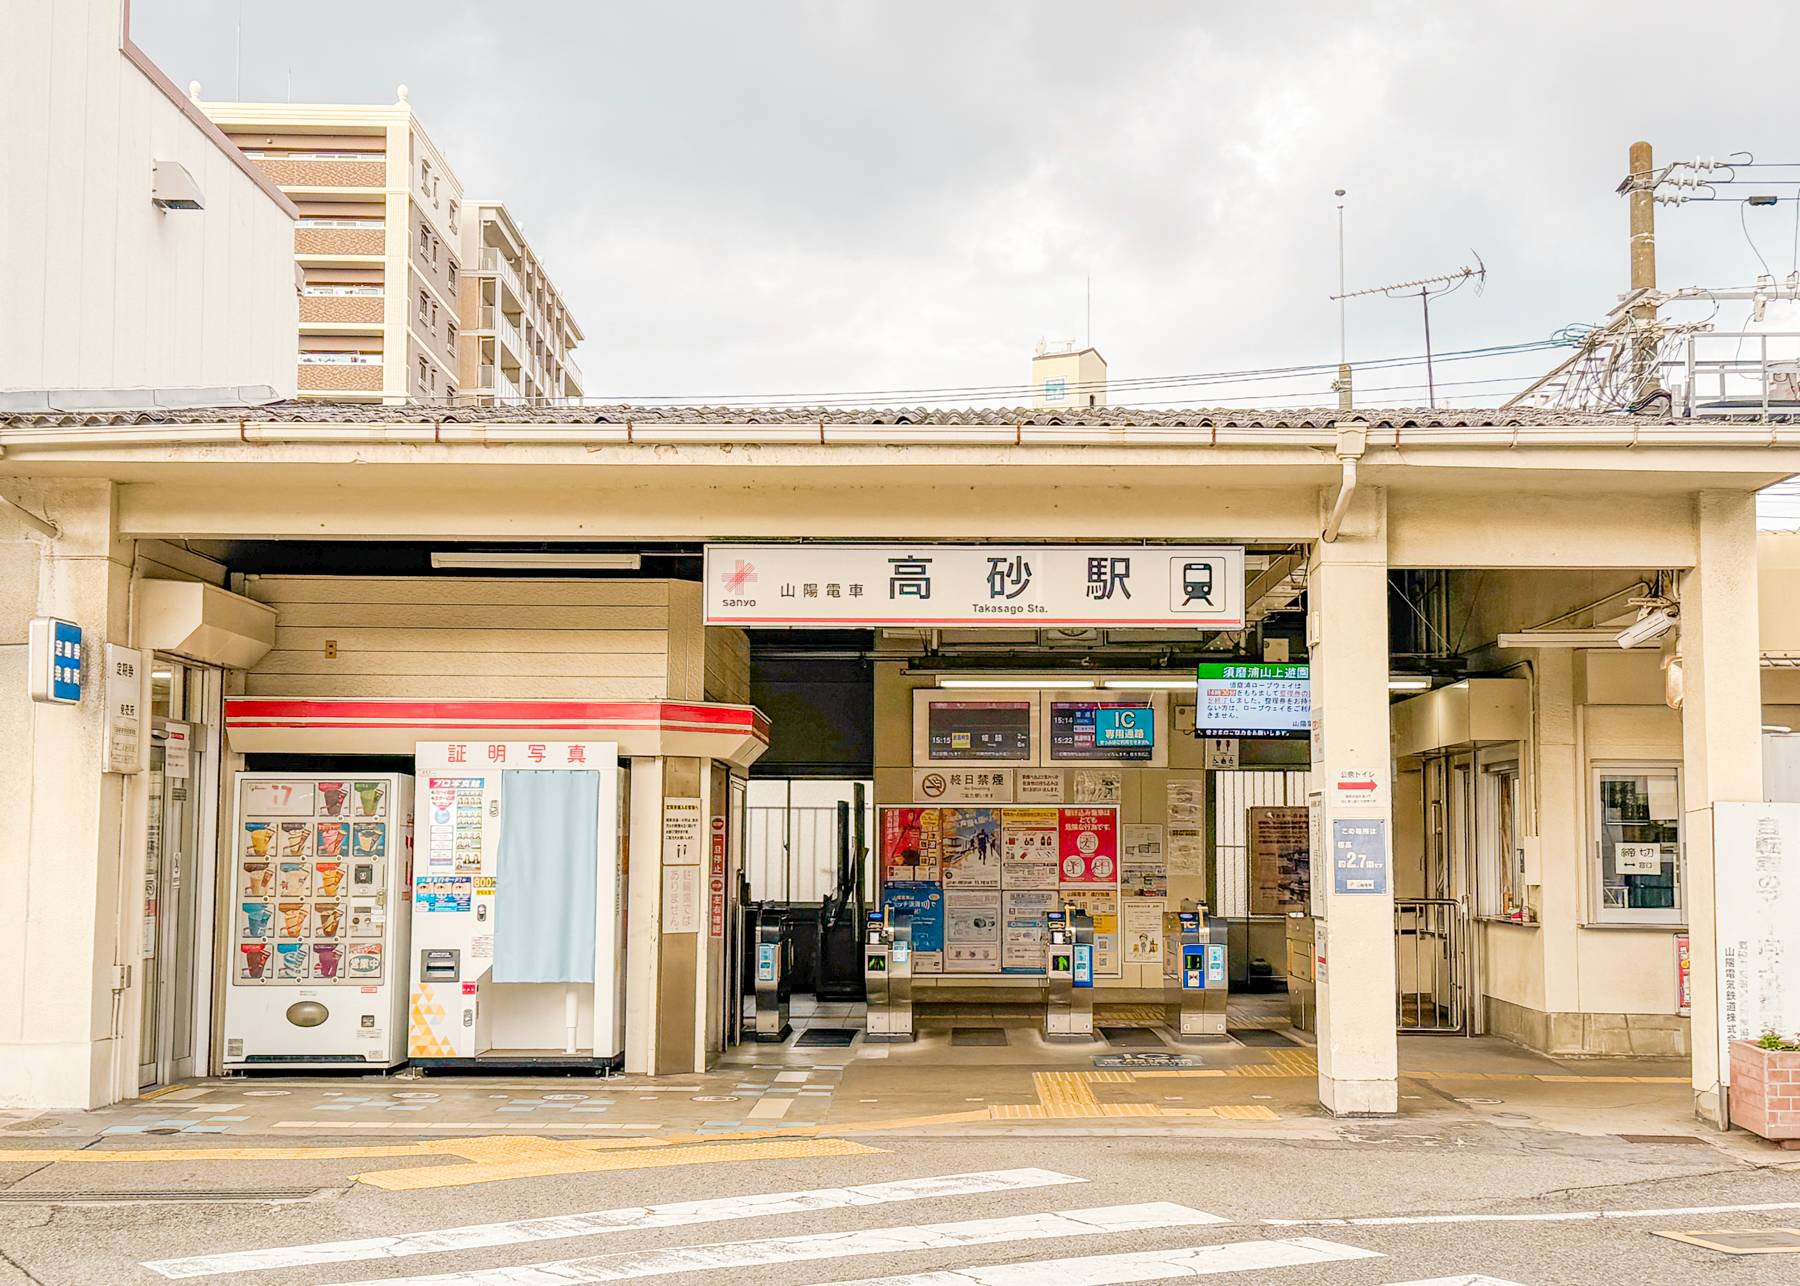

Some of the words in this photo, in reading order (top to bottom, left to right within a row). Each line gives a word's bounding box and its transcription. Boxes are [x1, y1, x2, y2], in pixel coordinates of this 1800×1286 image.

[888, 555, 1131, 600] 高砂駅
[780, 583, 864, 599] 山陽電車
[722, 598, 757, 609] sanyo
[972, 603, 1025, 615] Takasago
[1027, 603, 1049, 614] Sta.
[116, 662, 134, 678] 定期券
[1223, 666, 1309, 679] 須磨浦山上遊園
[1114, 711, 1135, 728] IC
[1105, 728, 1144, 739] 専用通路
[932, 736, 951, 744] 15:15
[1054, 736, 1073, 744] 15:22
[448, 744, 587, 764] 証明写真
[950, 773, 1004, 785] 終日禁煙
[1620, 847, 1654, 858] 締切
[1725, 947, 1737, 1050] 山陽電気鉄道株式会
